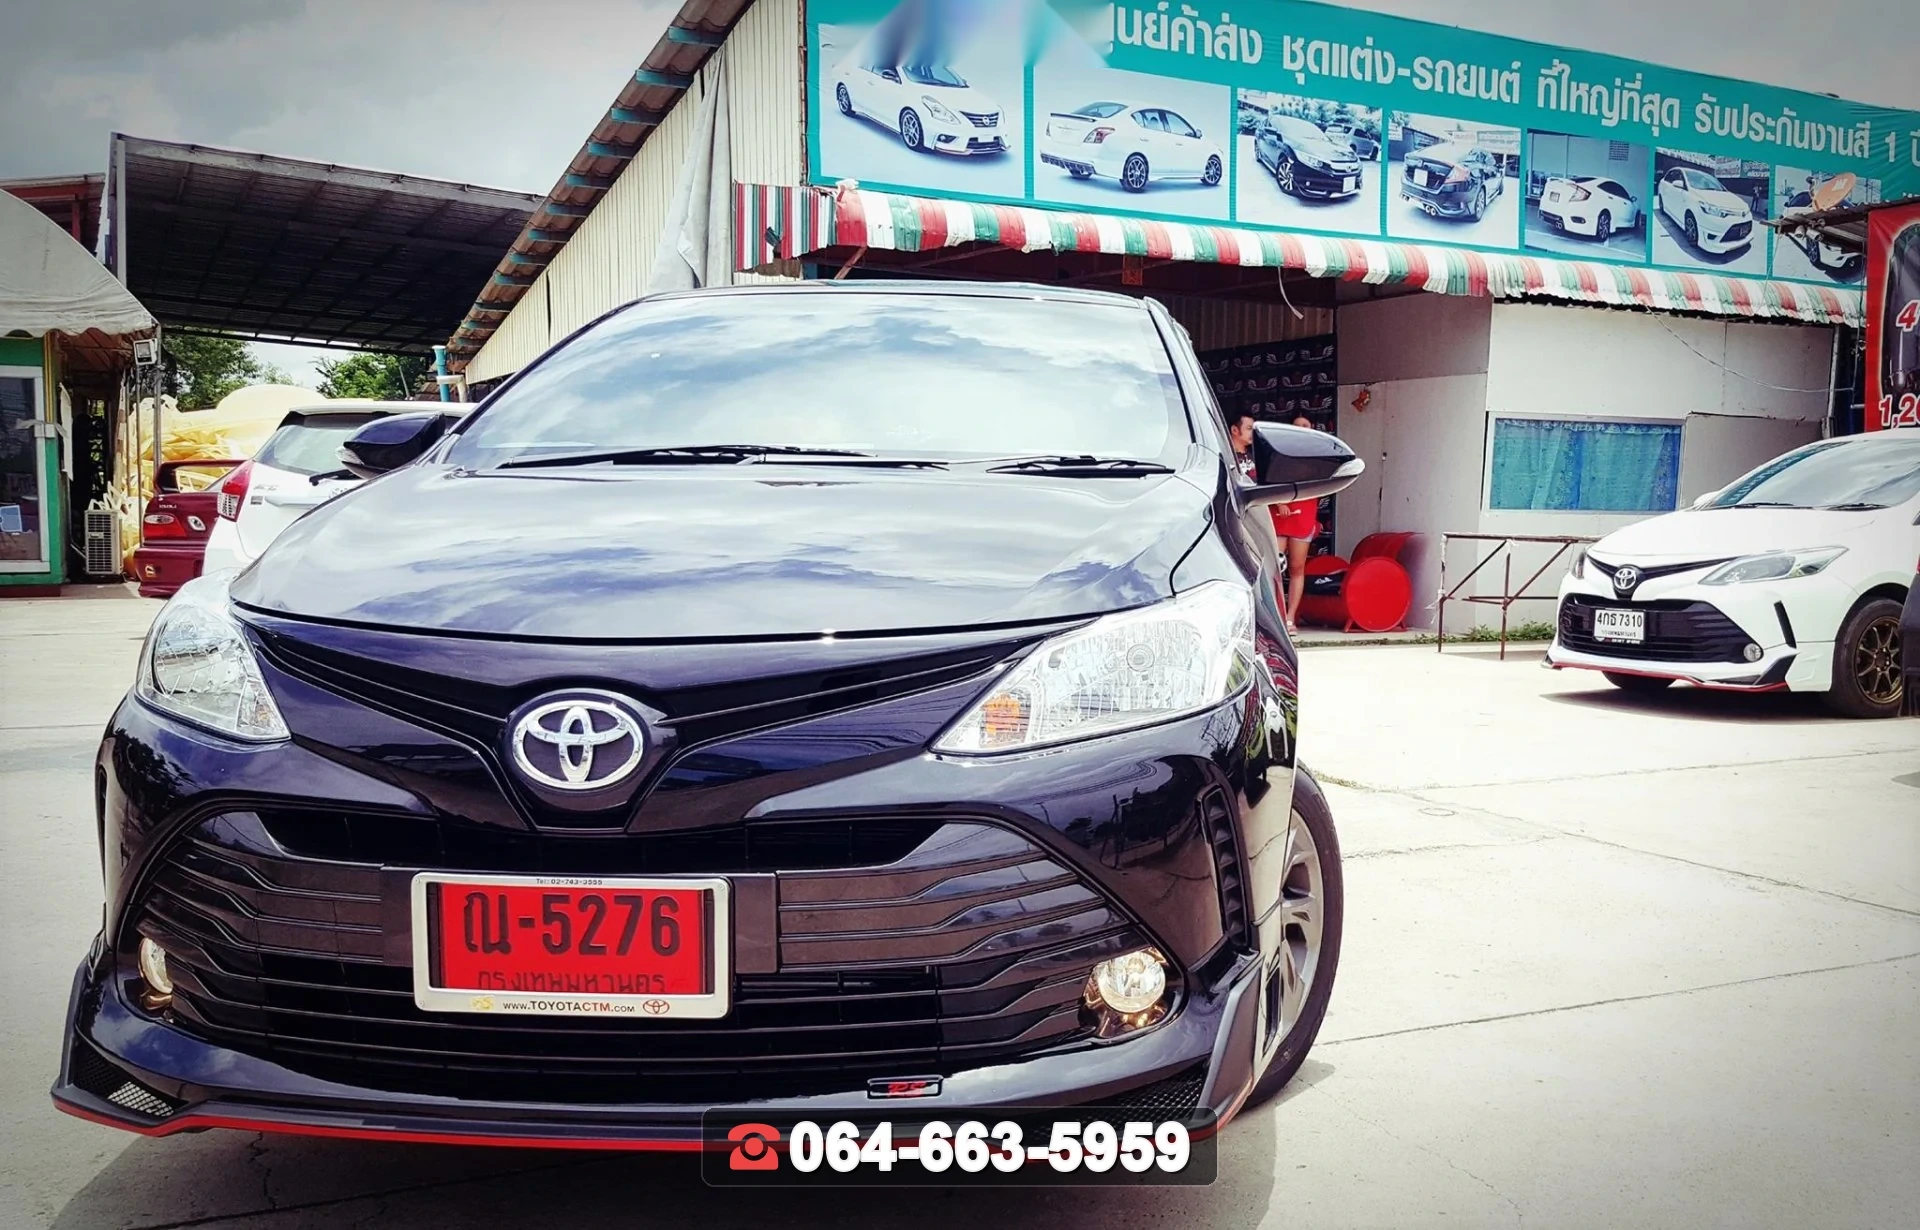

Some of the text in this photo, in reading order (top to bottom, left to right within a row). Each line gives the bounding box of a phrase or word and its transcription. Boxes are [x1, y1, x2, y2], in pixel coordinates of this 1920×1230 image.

[1108, 1, 1263, 65] นย์ค้าส่ง
[1281, 35, 1521, 105] ชุดแต่ง-รถยนต์
[1536, 58, 1681, 138] ที่ใหญ่ที่สุด
[1694, 93, 1871, 160] รับประกันงานสี
[1884, 131, 1897, 163] 1
[1878, 393, 1920, 429] 1,2
[1619, 613, 1643, 628] 7310
